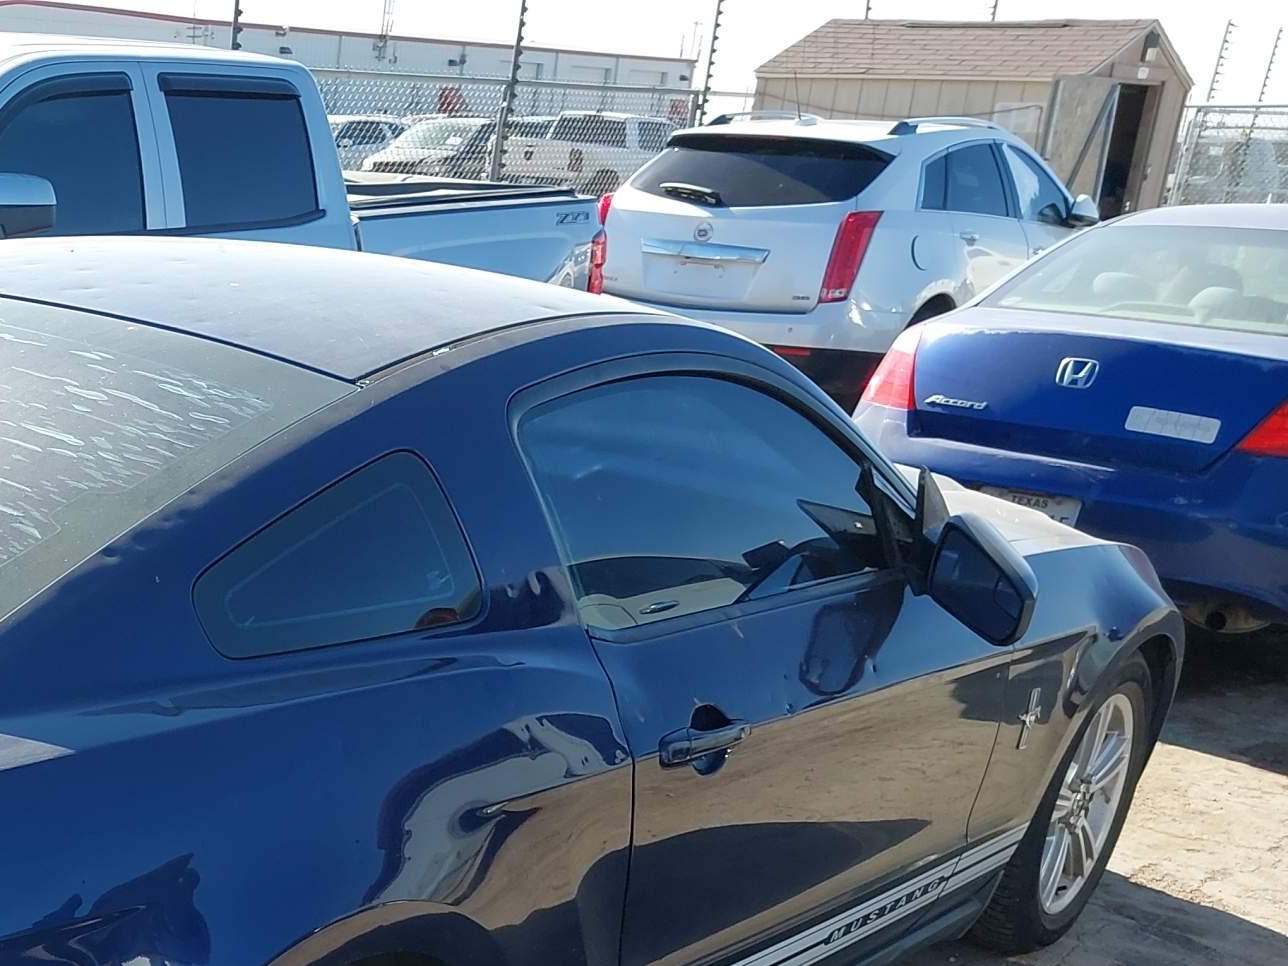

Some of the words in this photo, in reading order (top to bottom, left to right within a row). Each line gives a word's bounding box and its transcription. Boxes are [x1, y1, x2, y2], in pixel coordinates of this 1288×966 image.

[924, 394, 988, 410] Accord
[1011, 495, 1049, 509] TEXAS
[830, 880, 941, 942] MUSTANG
